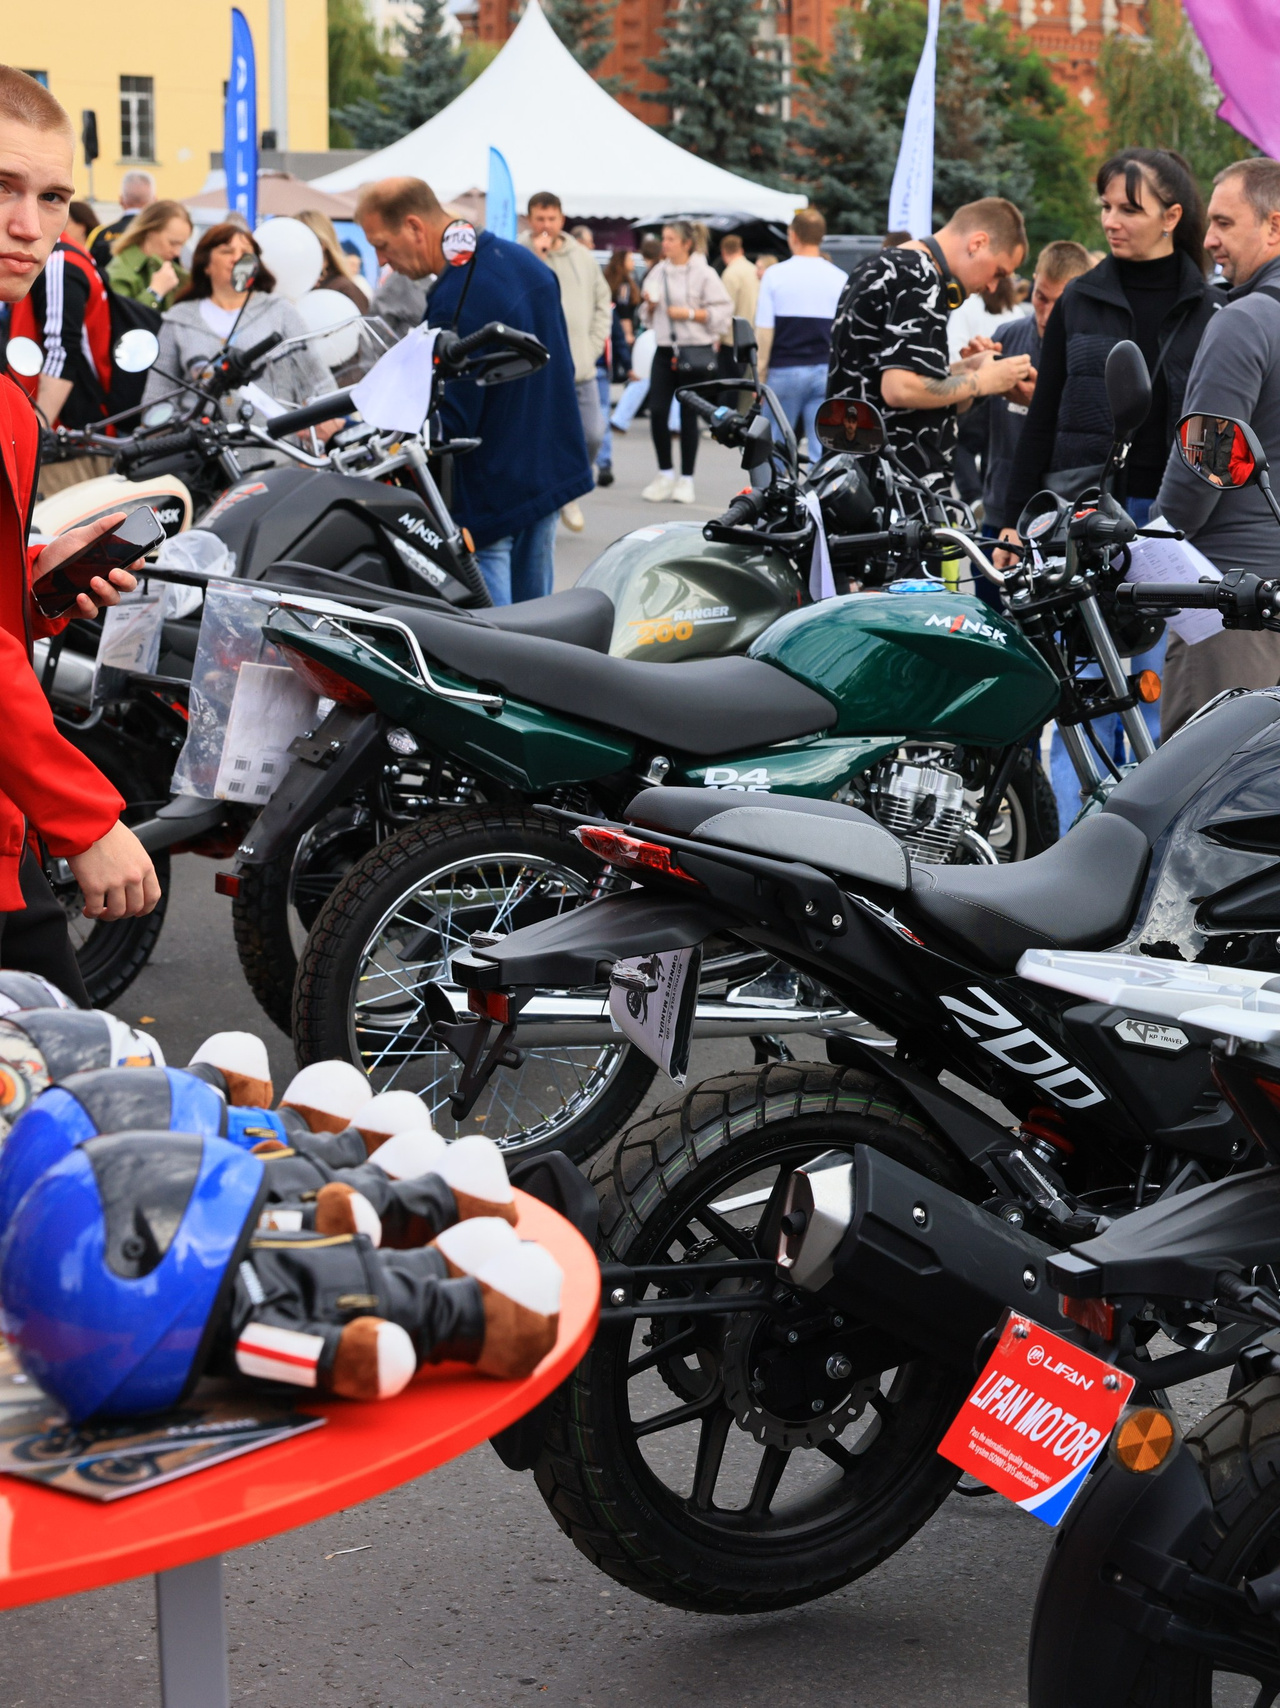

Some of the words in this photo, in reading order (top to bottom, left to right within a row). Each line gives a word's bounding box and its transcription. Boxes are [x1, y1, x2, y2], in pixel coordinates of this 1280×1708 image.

[398, 512, 443, 550] MINSK
[673, 606, 729, 621] RANGER
[924, 613, 1008, 645] MINSK
[637, 621, 694, 646] 200
[704, 767, 771, 785] D4
[664, 954, 679, 998] OWNER'S
[657, 999, 669, 1038] MANUAL
[938, 986, 1107, 1109] 200
[1160, 1035, 1184, 1045] TRAVEL
[1043, 1355, 1095, 1391] LIFAN
[969, 1370, 1035, 1426] LIFAN
[1013, 1397, 1101, 1467] MOTOR
[968, 1441, 976, 1449] the
[973, 1445, 989, 1459] system
[1014, 1470, 1039, 1489] attestation
[969, 1426, 981, 1438] Pass
[978, 1433, 987, 1441] the
[984, 1437, 1010, 1457] international
[1007, 1451, 1024, 1467] quality
